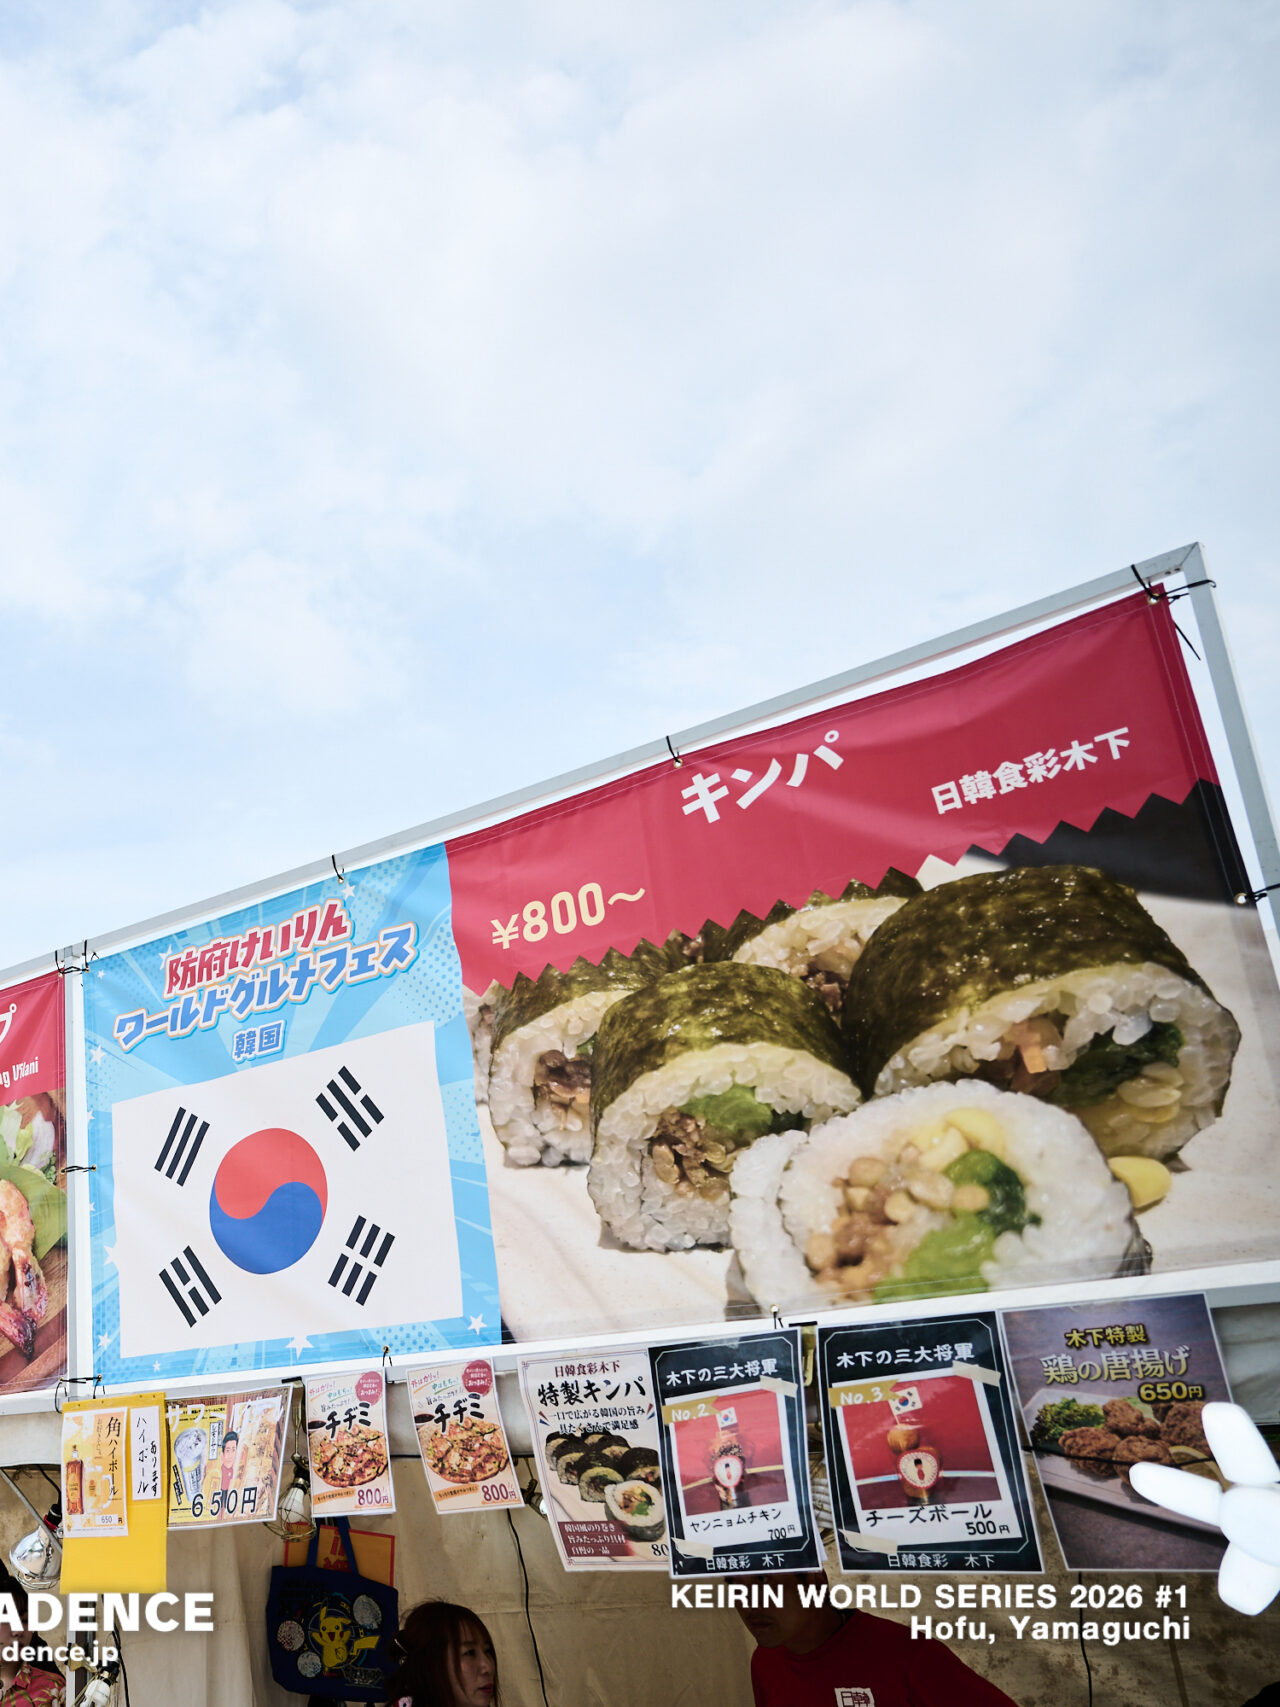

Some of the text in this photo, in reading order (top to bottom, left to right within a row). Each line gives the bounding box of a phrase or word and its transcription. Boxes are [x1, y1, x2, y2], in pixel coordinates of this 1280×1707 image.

[681, 729, 844, 824] キンパ
[930, 726, 1132, 815] 日韓食彩木下
[165, 902, 350, 996] 防府けいりん
[235, 1022, 282, 1059] 韓国
[1064, 1324, 1148, 1348] 木下特製
[554, 1360, 621, 1378] 日韓食彩木下
[836, 1342, 976, 1370] 木下の三大将軍
[1040, 1345, 1192, 1385] 鶏の唐揚げ
[666, 1358, 778, 1387] 木下の三大将軍
[537, 1376, 646, 1407] 特製キンパ
[1138, 1382, 1204, 1402] 650円
[325, 1402, 371, 1439] チヂミ
[433, 1393, 484, 1433] チヂミ
[106, 1416, 121, 1496] 角ハイボール
[136, 1416, 149, 1494] ハイボール
[150, 1440, 158, 1497] あります
[357, 1487, 389, 1505] 800円
[481, 1483, 517, 1501] 800円
[689, 1508, 783, 1533] ヤンニョムチキン
[865, 1503, 993, 1528] チーズボール
[965, 1520, 1010, 1536] 500円
[767, 1523, 796, 1540] 700円
[888, 1553, 995, 1568] 日韓食彩 木下
